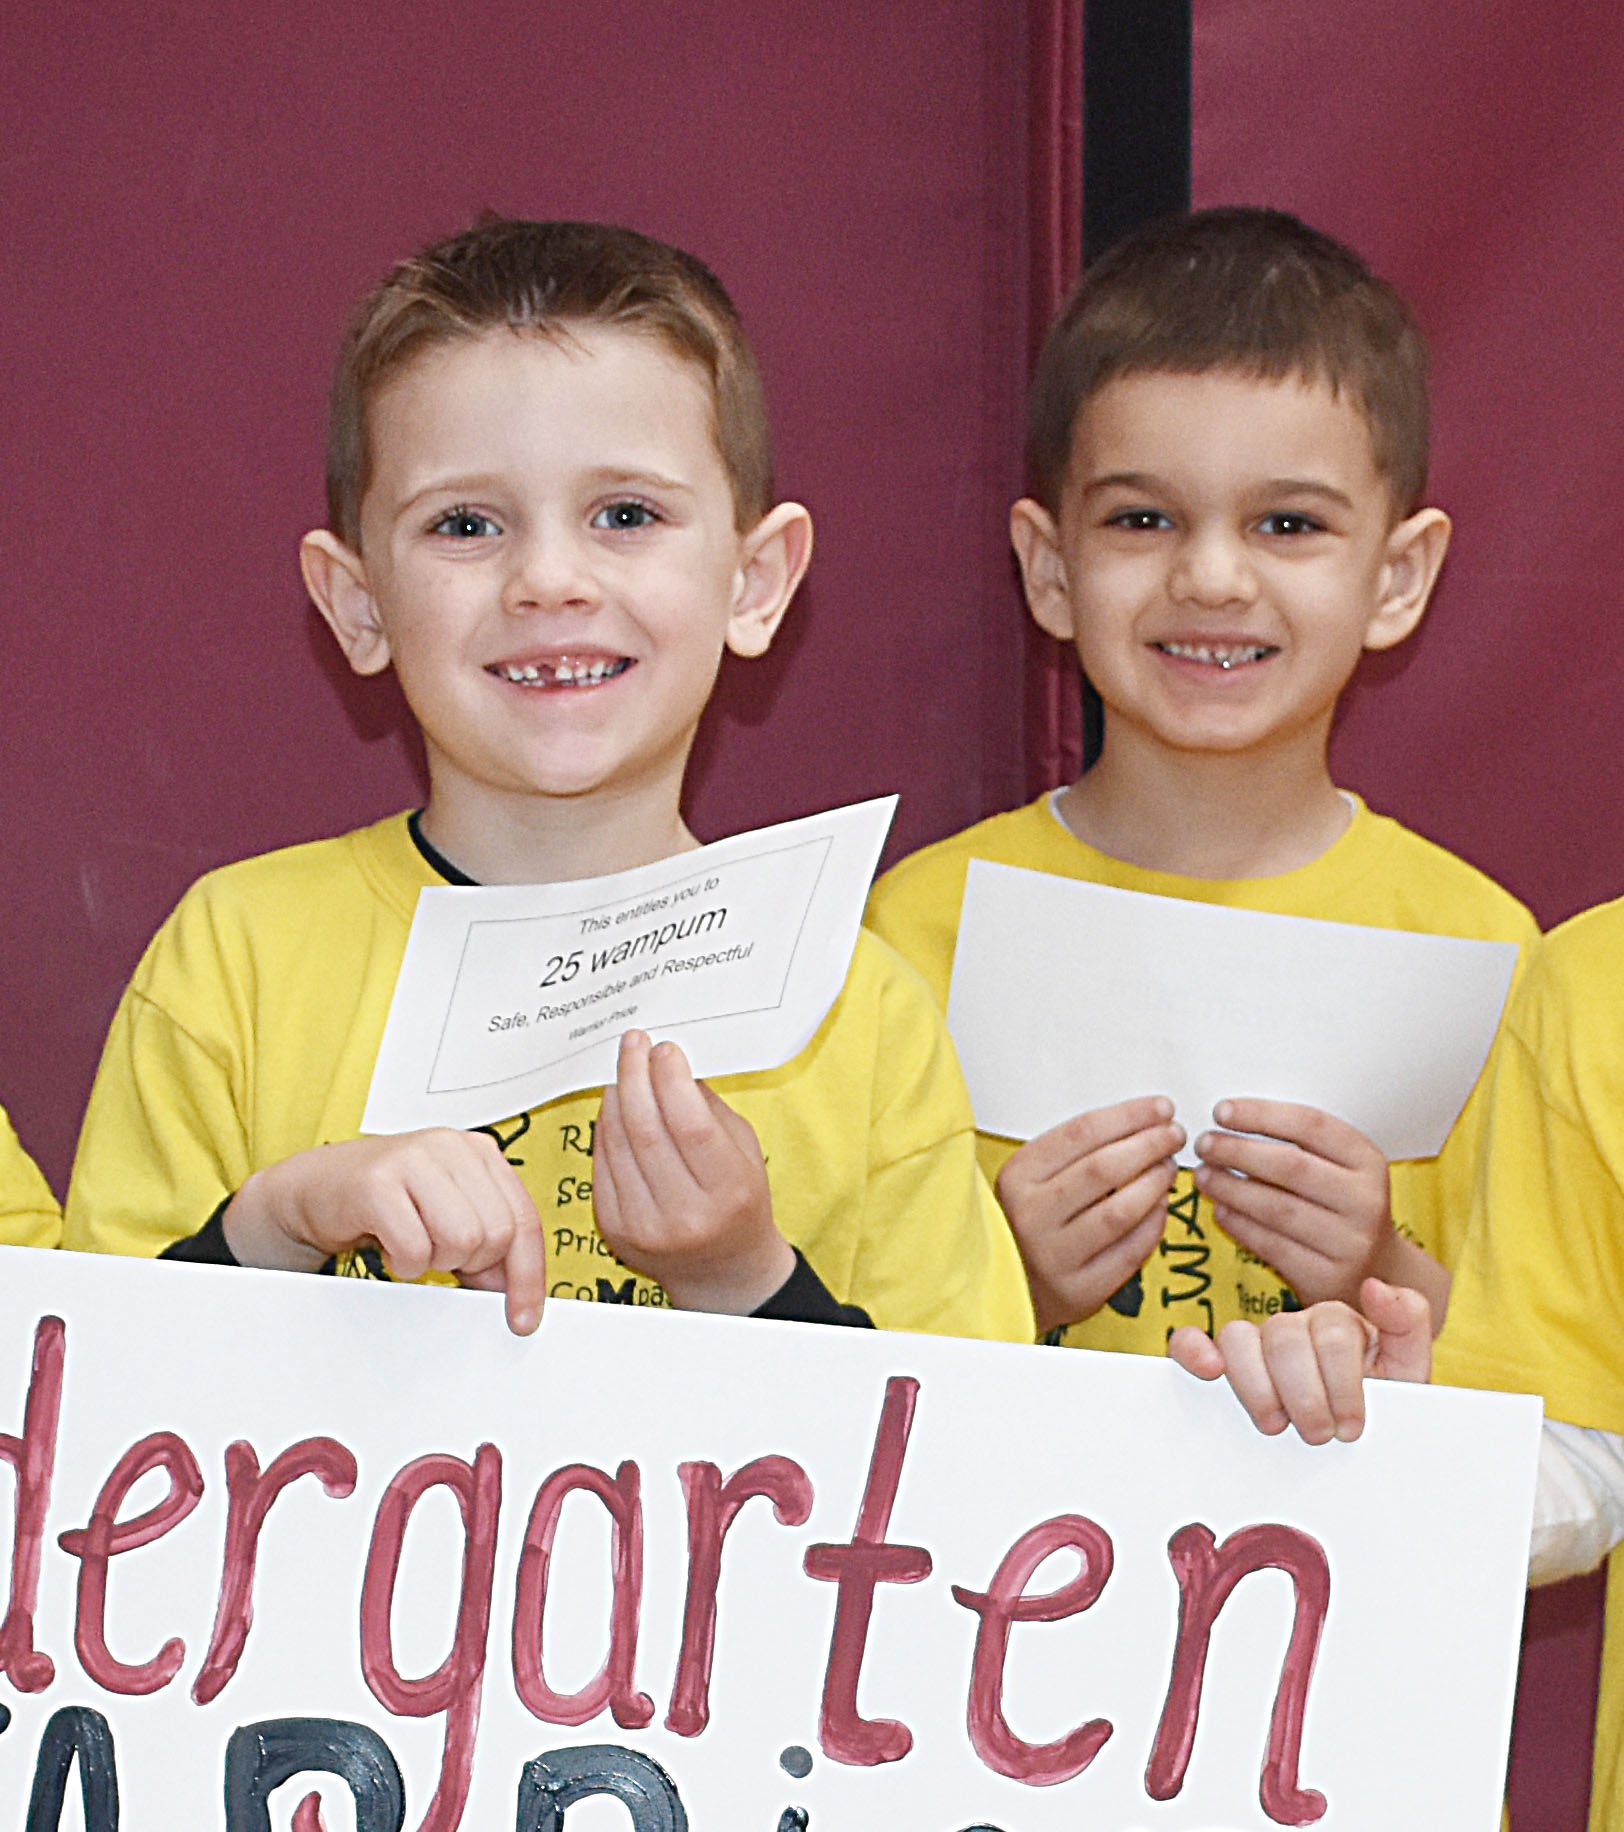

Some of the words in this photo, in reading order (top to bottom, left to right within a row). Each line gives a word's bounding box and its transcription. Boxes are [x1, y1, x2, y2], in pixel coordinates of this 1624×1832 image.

[580, 914, 611, 935] This
[615, 898, 668, 926] entitles
[672, 881, 700, 908] you
[704, 876, 720, 892] to
[536, 979, 626, 1024] Responsible
[628, 963, 659, 989] and
[660, 942, 754, 977] Respectful
[539, 951, 584, 988] 25
[590, 907, 727, 974] wampum
